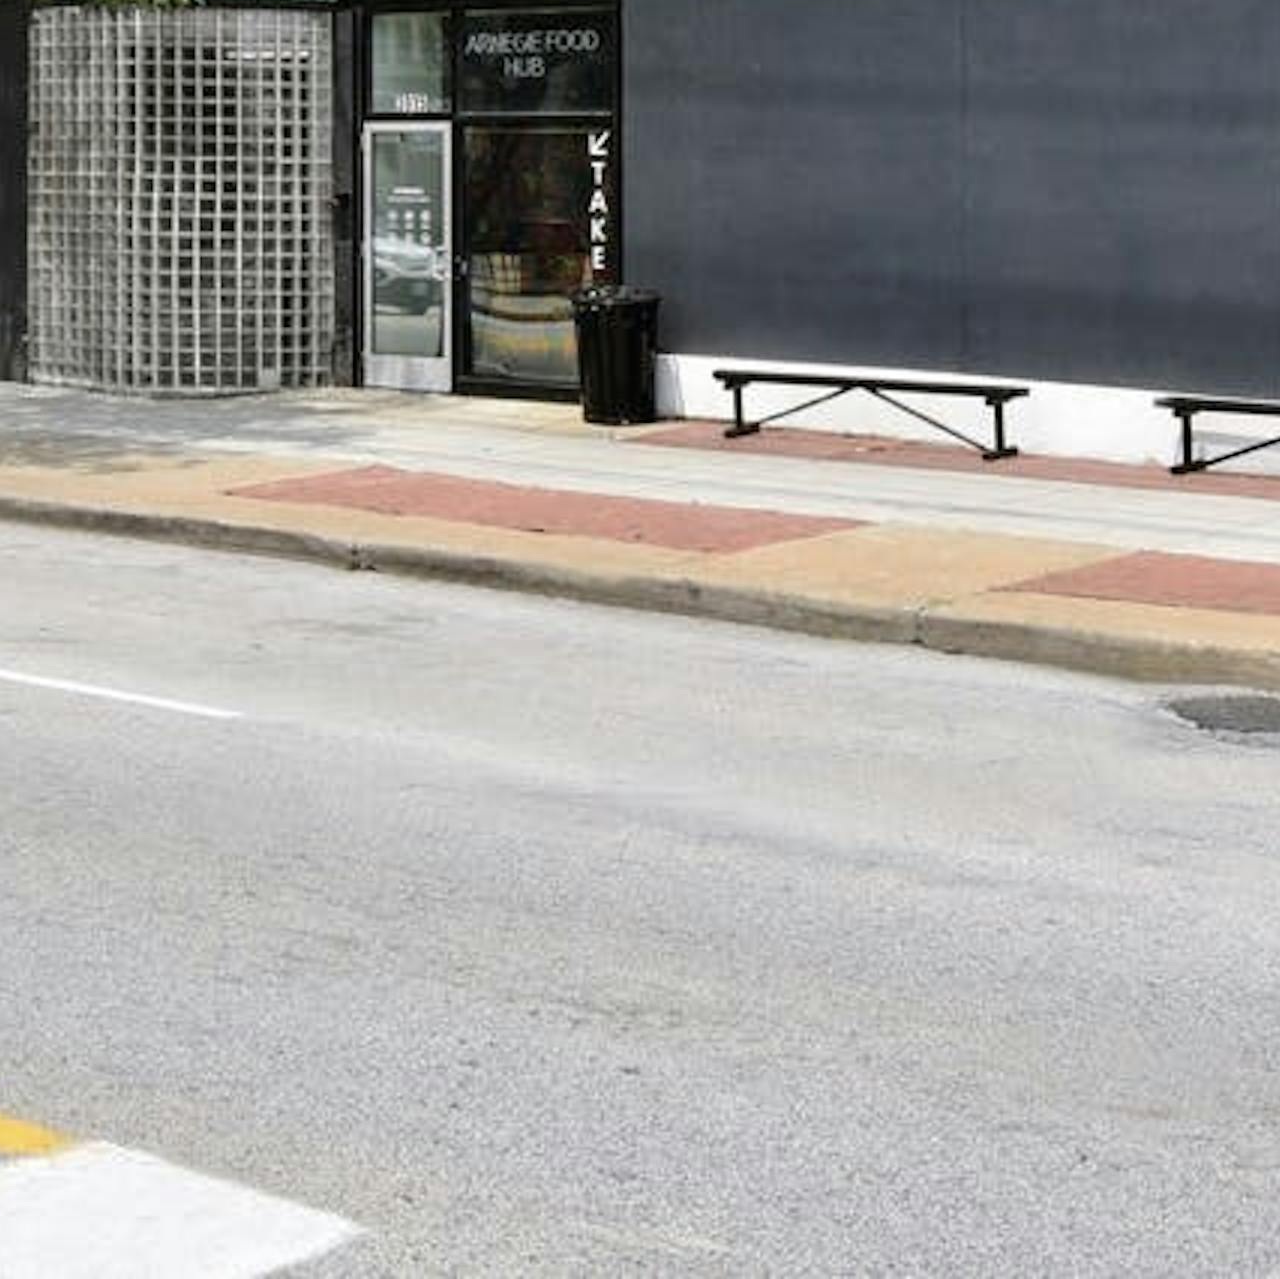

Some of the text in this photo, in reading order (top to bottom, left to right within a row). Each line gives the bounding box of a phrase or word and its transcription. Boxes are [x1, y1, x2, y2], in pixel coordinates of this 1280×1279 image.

[545, 29, 600, 52] FOOD
[503, 56, 546, 78] HUB
[588, 161, 608, 270] TAKE
